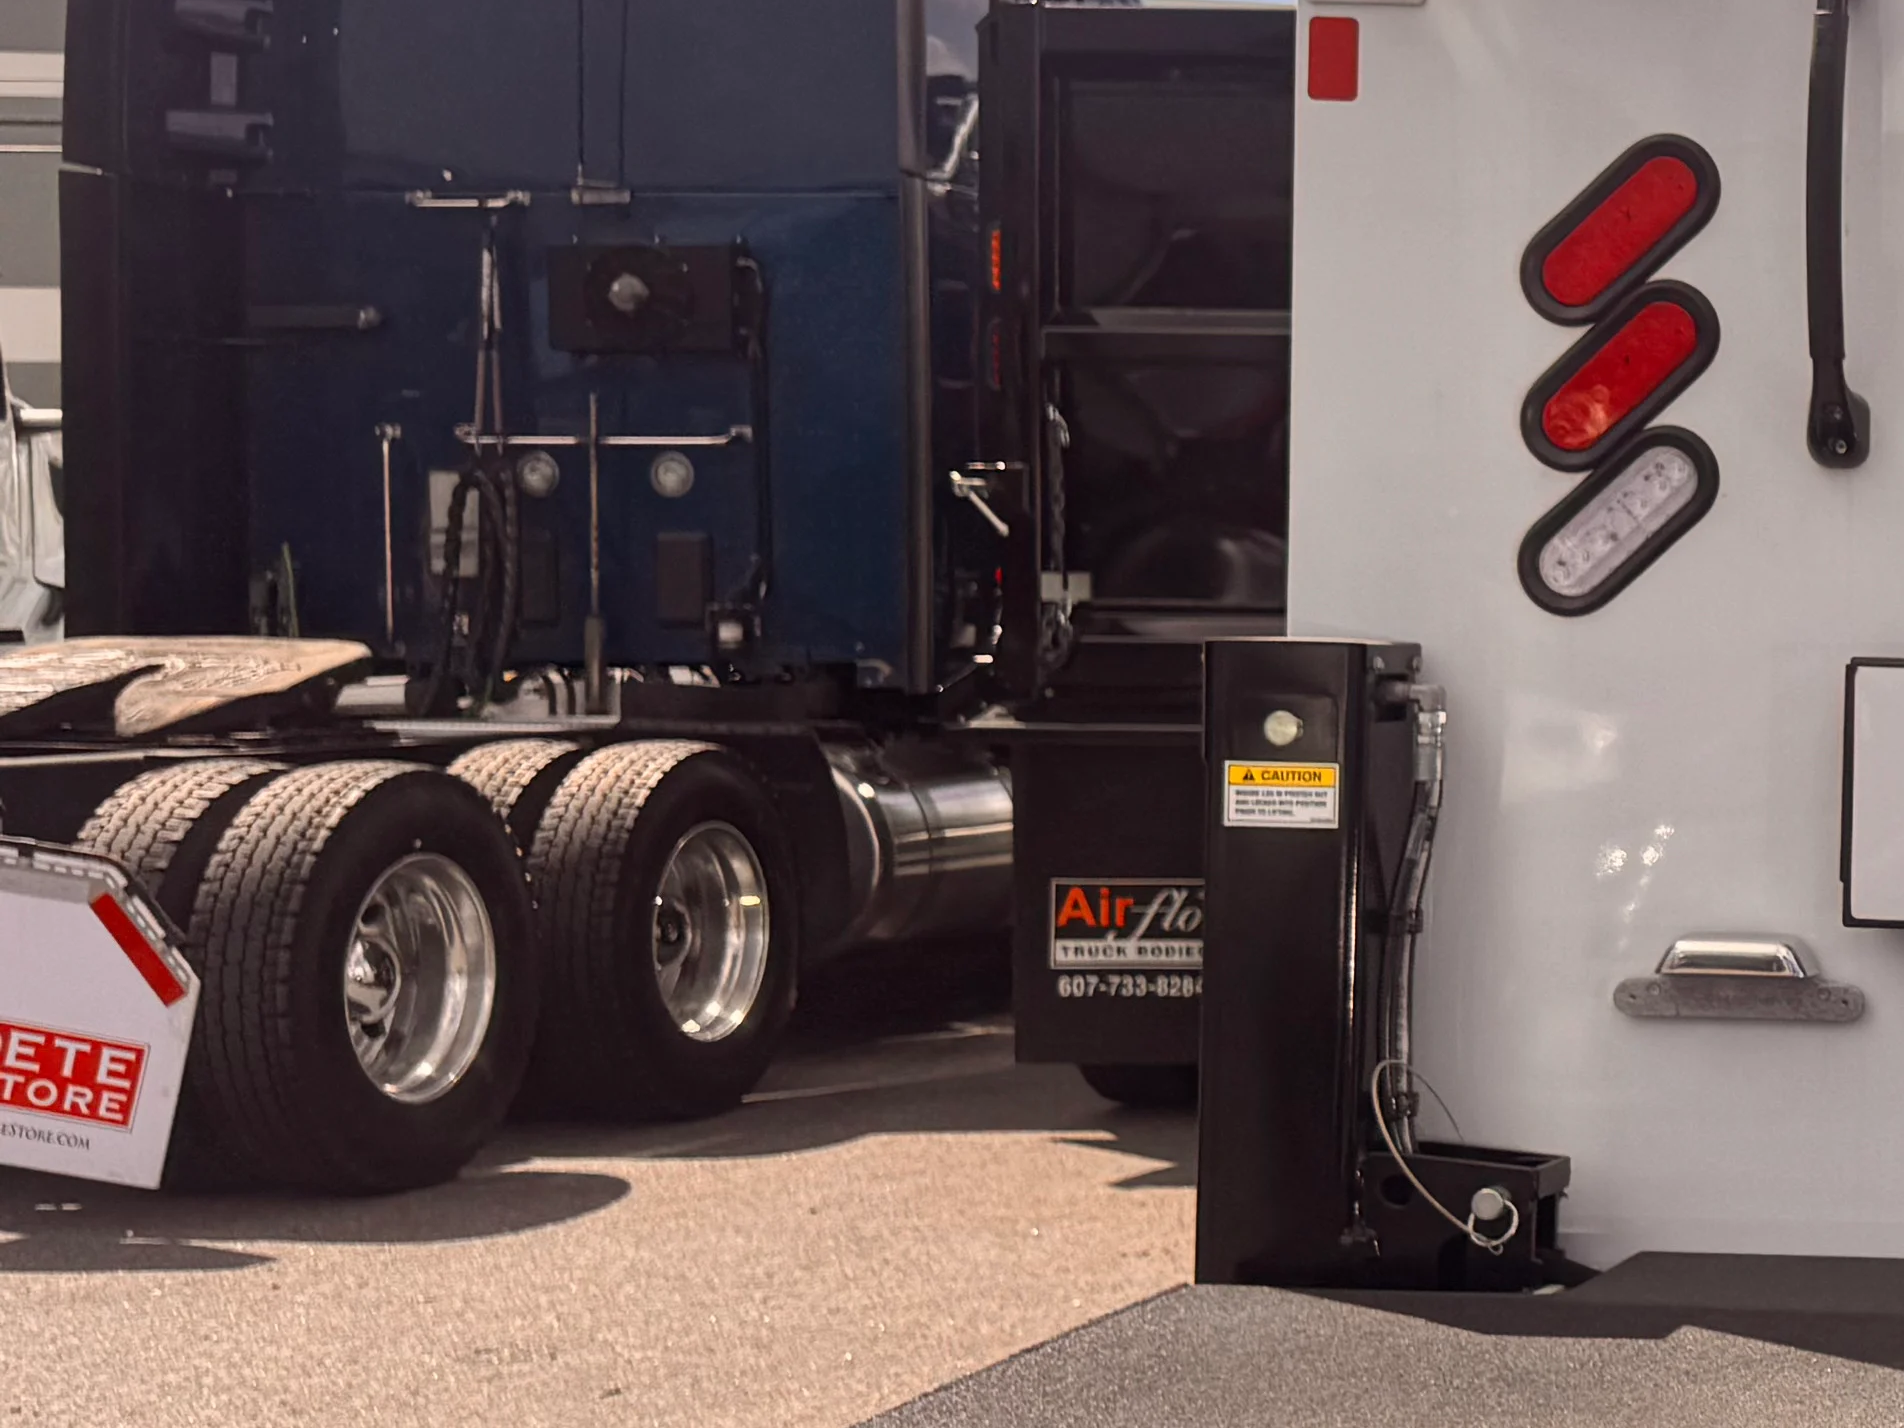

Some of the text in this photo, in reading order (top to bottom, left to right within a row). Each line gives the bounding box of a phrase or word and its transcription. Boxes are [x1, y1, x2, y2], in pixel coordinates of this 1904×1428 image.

[1261, 770, 1322, 783] CAUTION
[1061, 945, 1128, 958] TRUCK
[0, 1028, 136, 1090] ETE
